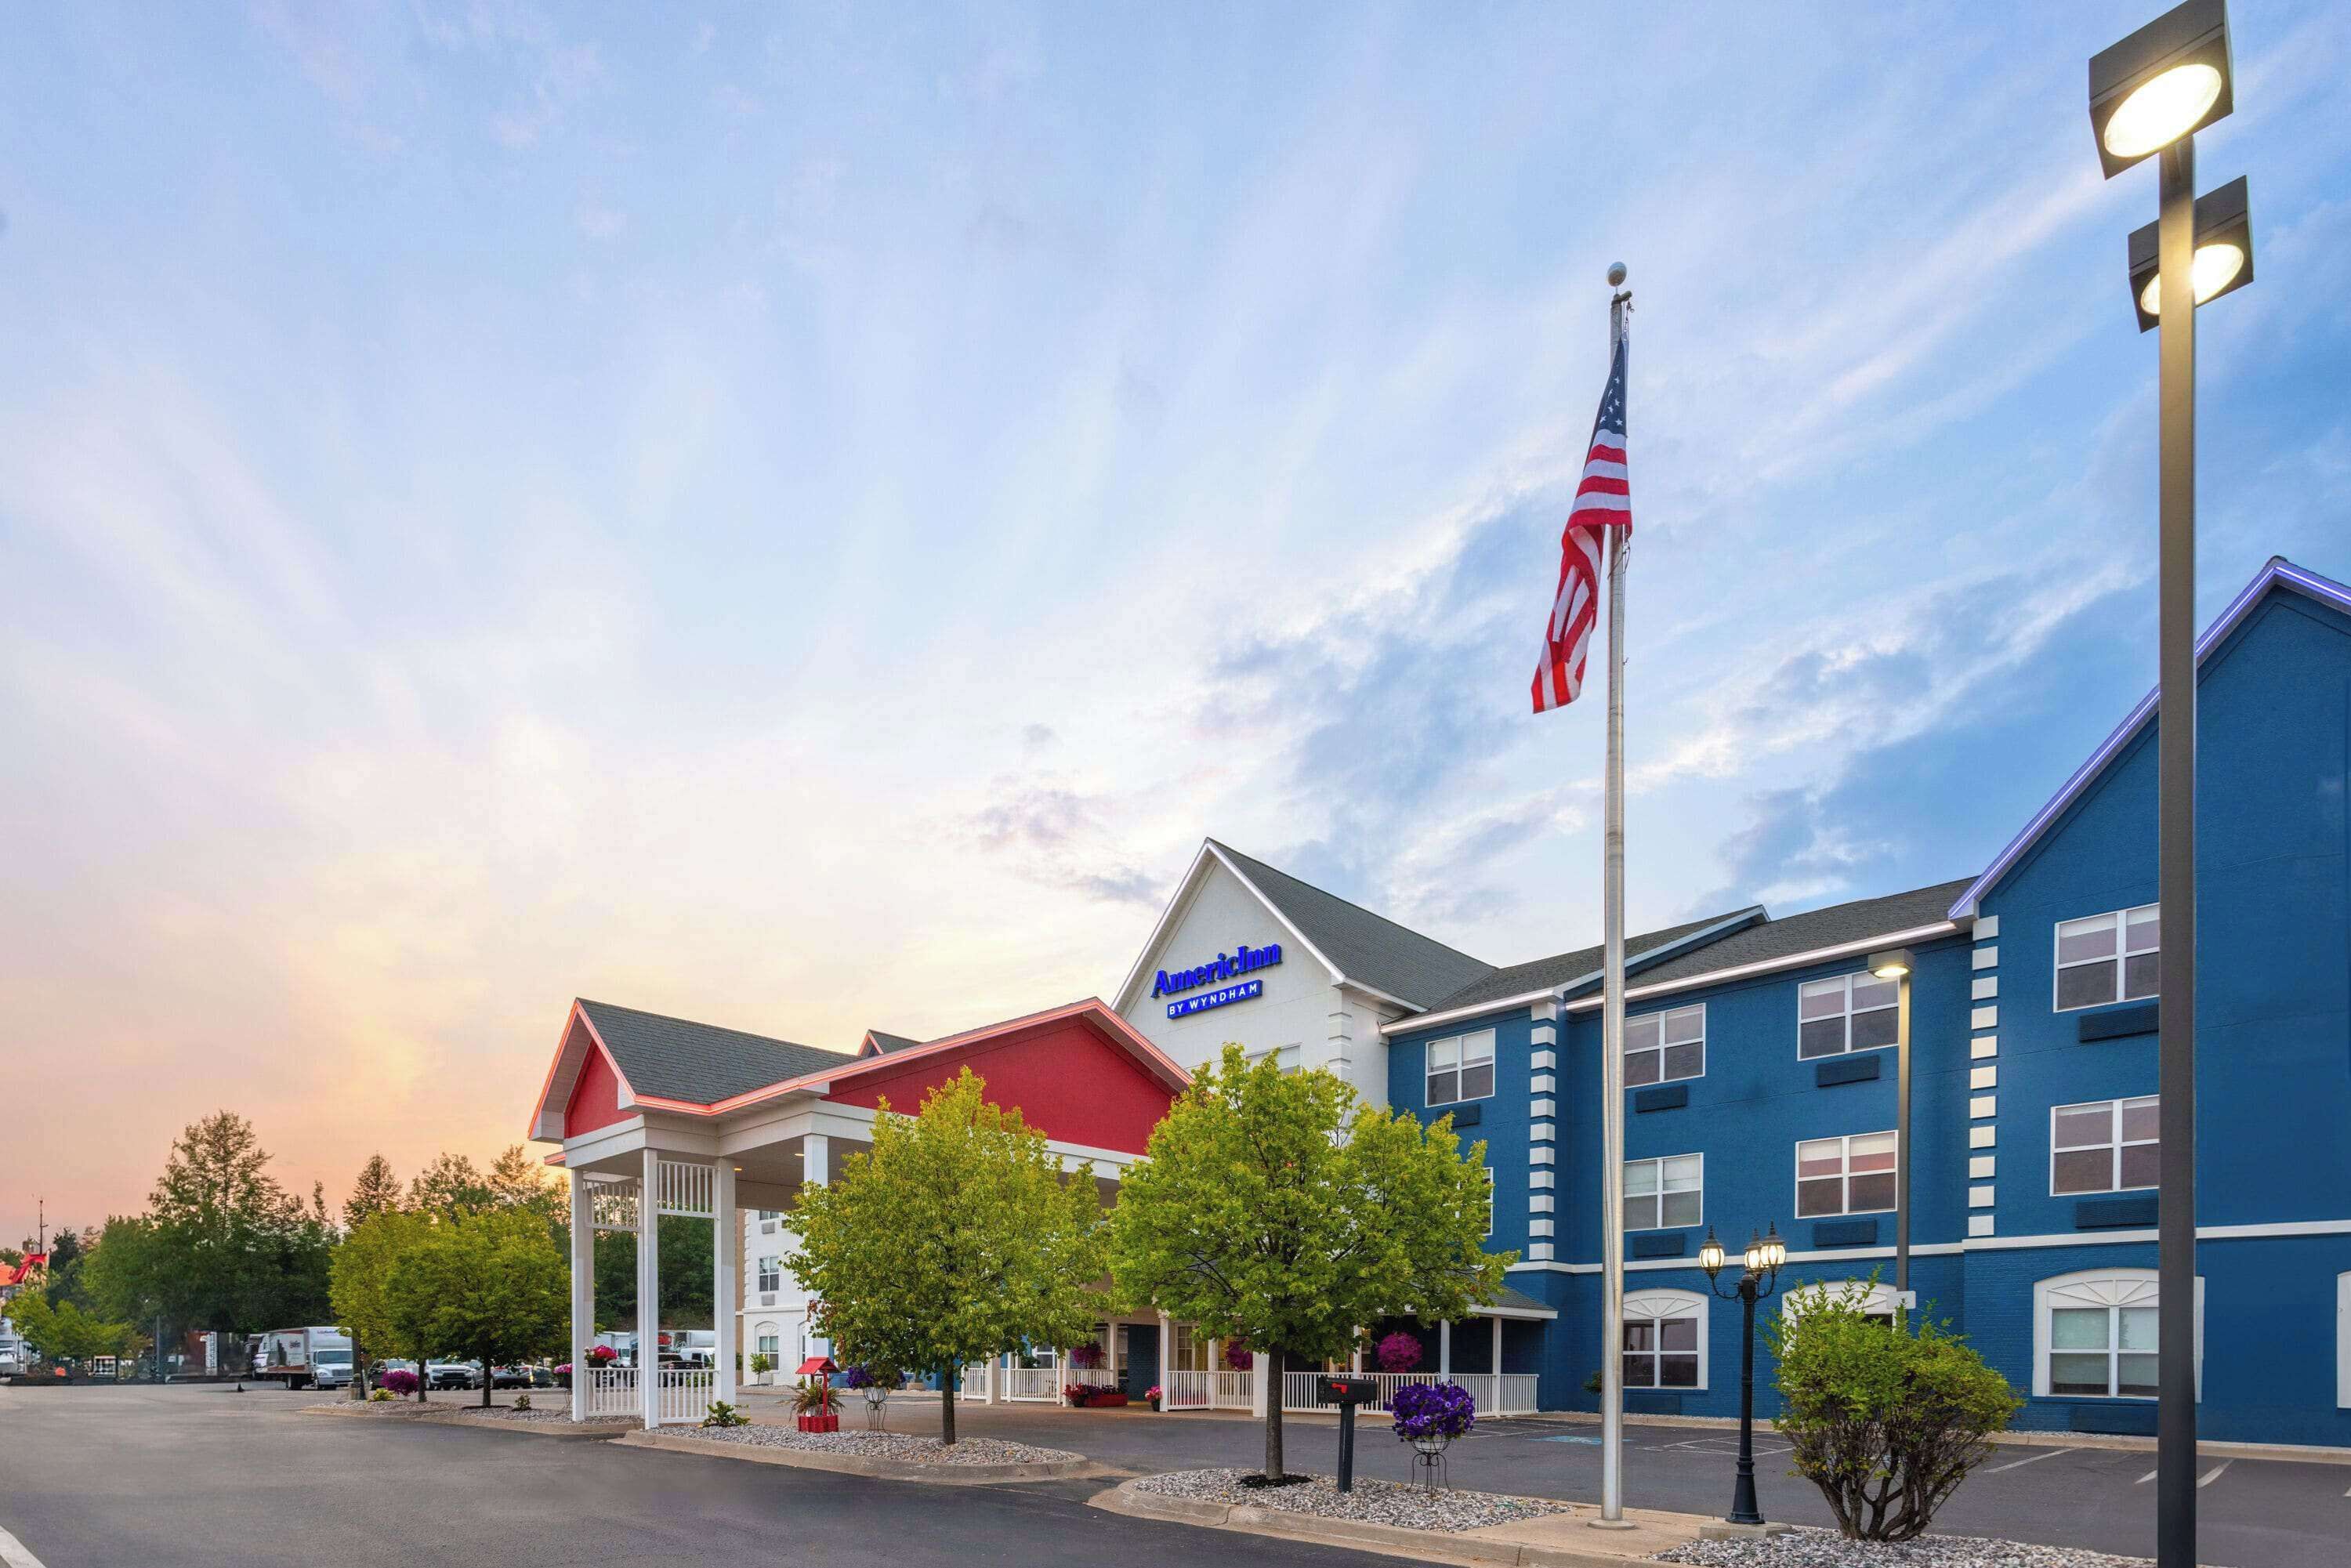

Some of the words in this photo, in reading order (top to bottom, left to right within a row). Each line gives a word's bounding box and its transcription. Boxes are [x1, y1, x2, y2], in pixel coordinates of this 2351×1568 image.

[1150, 943, 1283, 998] AmericInn
[1169, 1004, 1183, 1016] BY
[1190, 983, 1257, 1009] WYNDHAM
